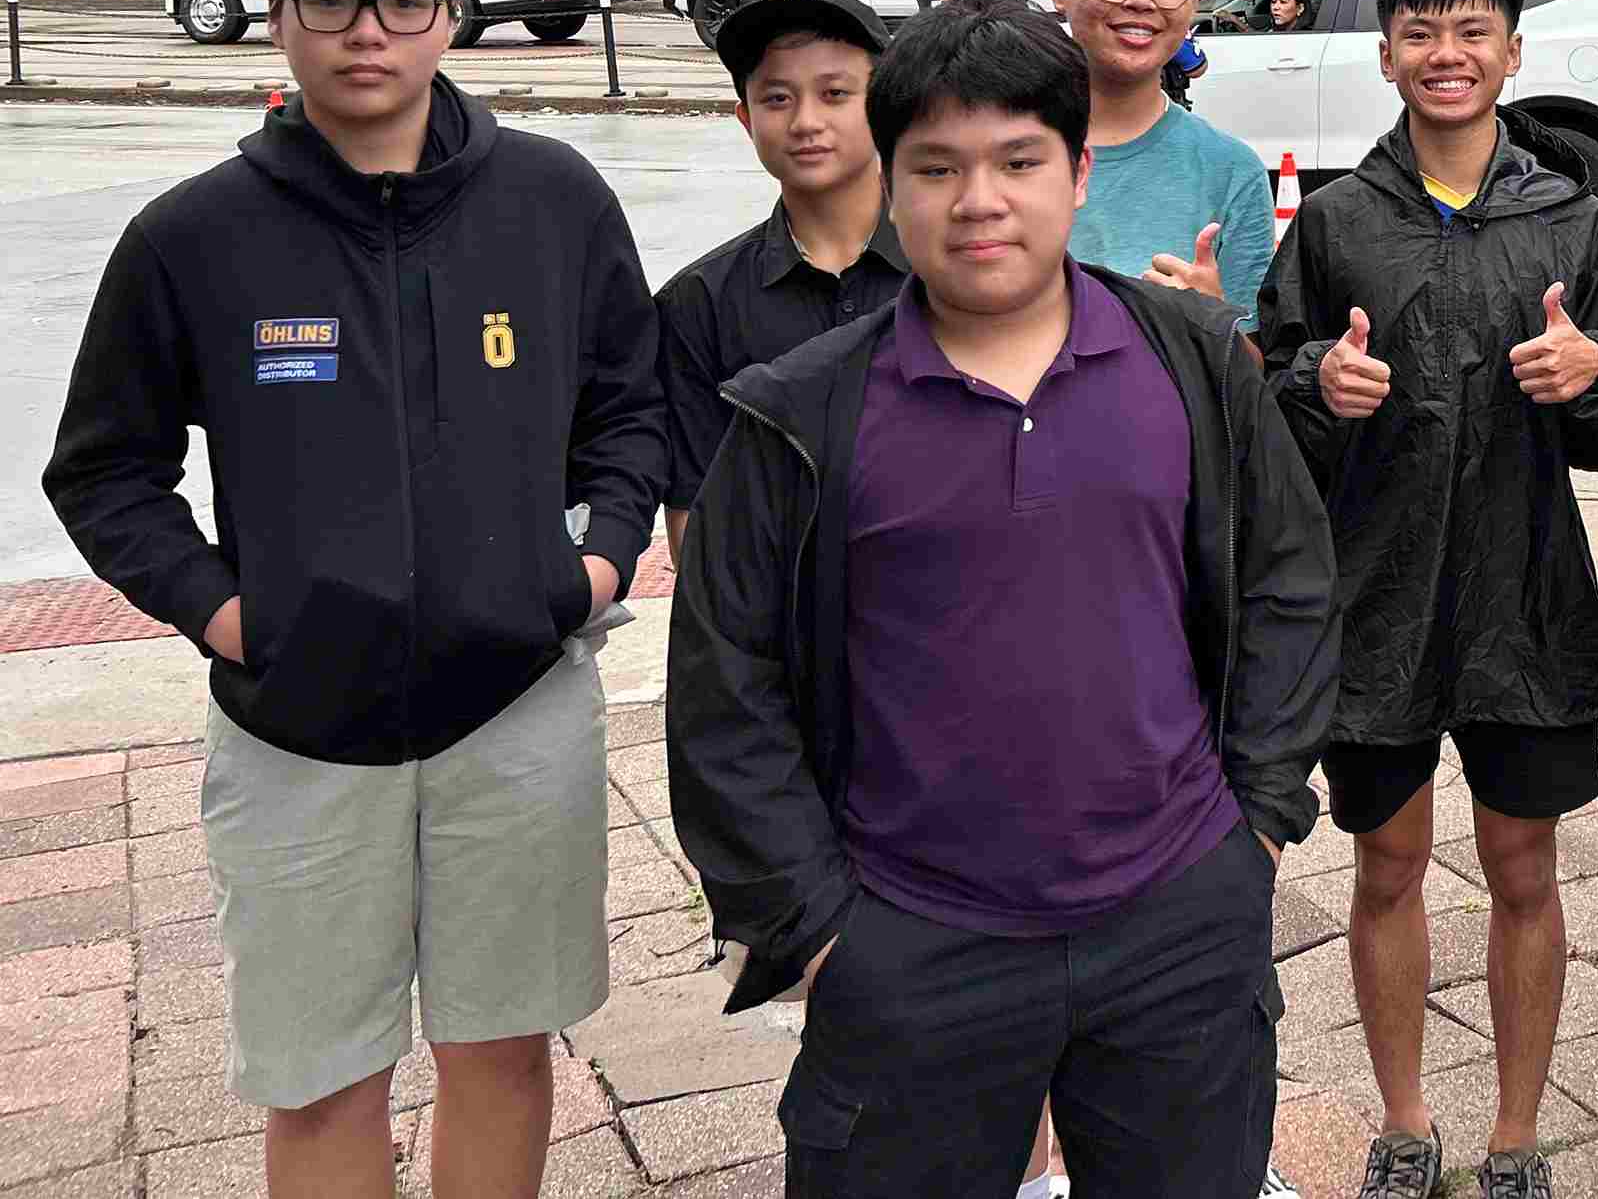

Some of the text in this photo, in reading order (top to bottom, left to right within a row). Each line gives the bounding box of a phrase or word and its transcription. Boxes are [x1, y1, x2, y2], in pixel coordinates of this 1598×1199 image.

[259, 322, 332, 345] ÖHLINS
[256, 360, 315, 372] AUTHORIZED
[256, 368, 317, 381] DISTRIBUTOR
